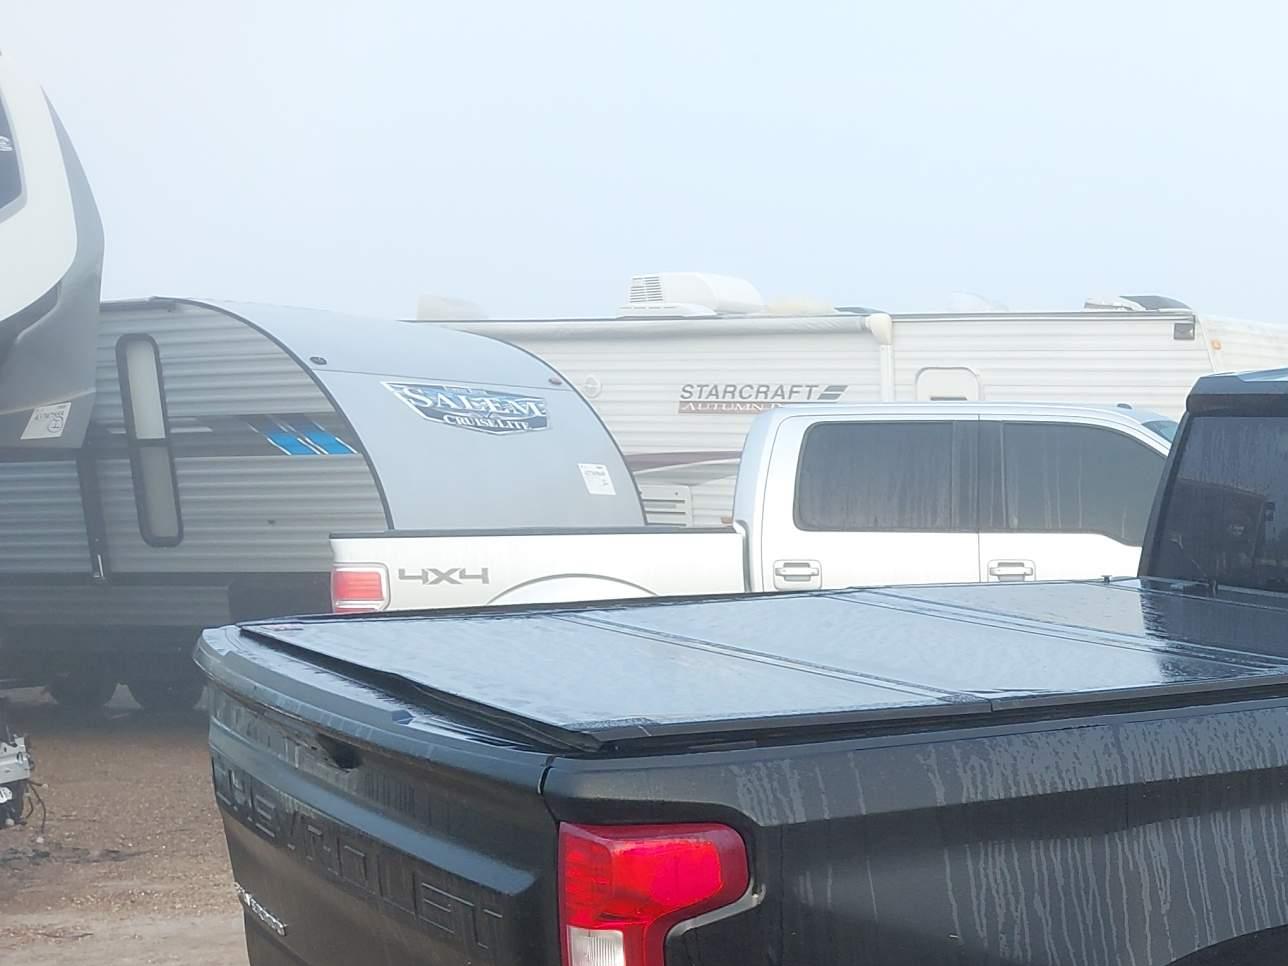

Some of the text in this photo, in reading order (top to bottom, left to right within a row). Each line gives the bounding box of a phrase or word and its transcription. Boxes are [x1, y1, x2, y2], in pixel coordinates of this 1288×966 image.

[680, 384, 819, 400] STARCRAFT
[402, 386, 546, 417] SALEM
[398, 567, 489, 585] 4X4
